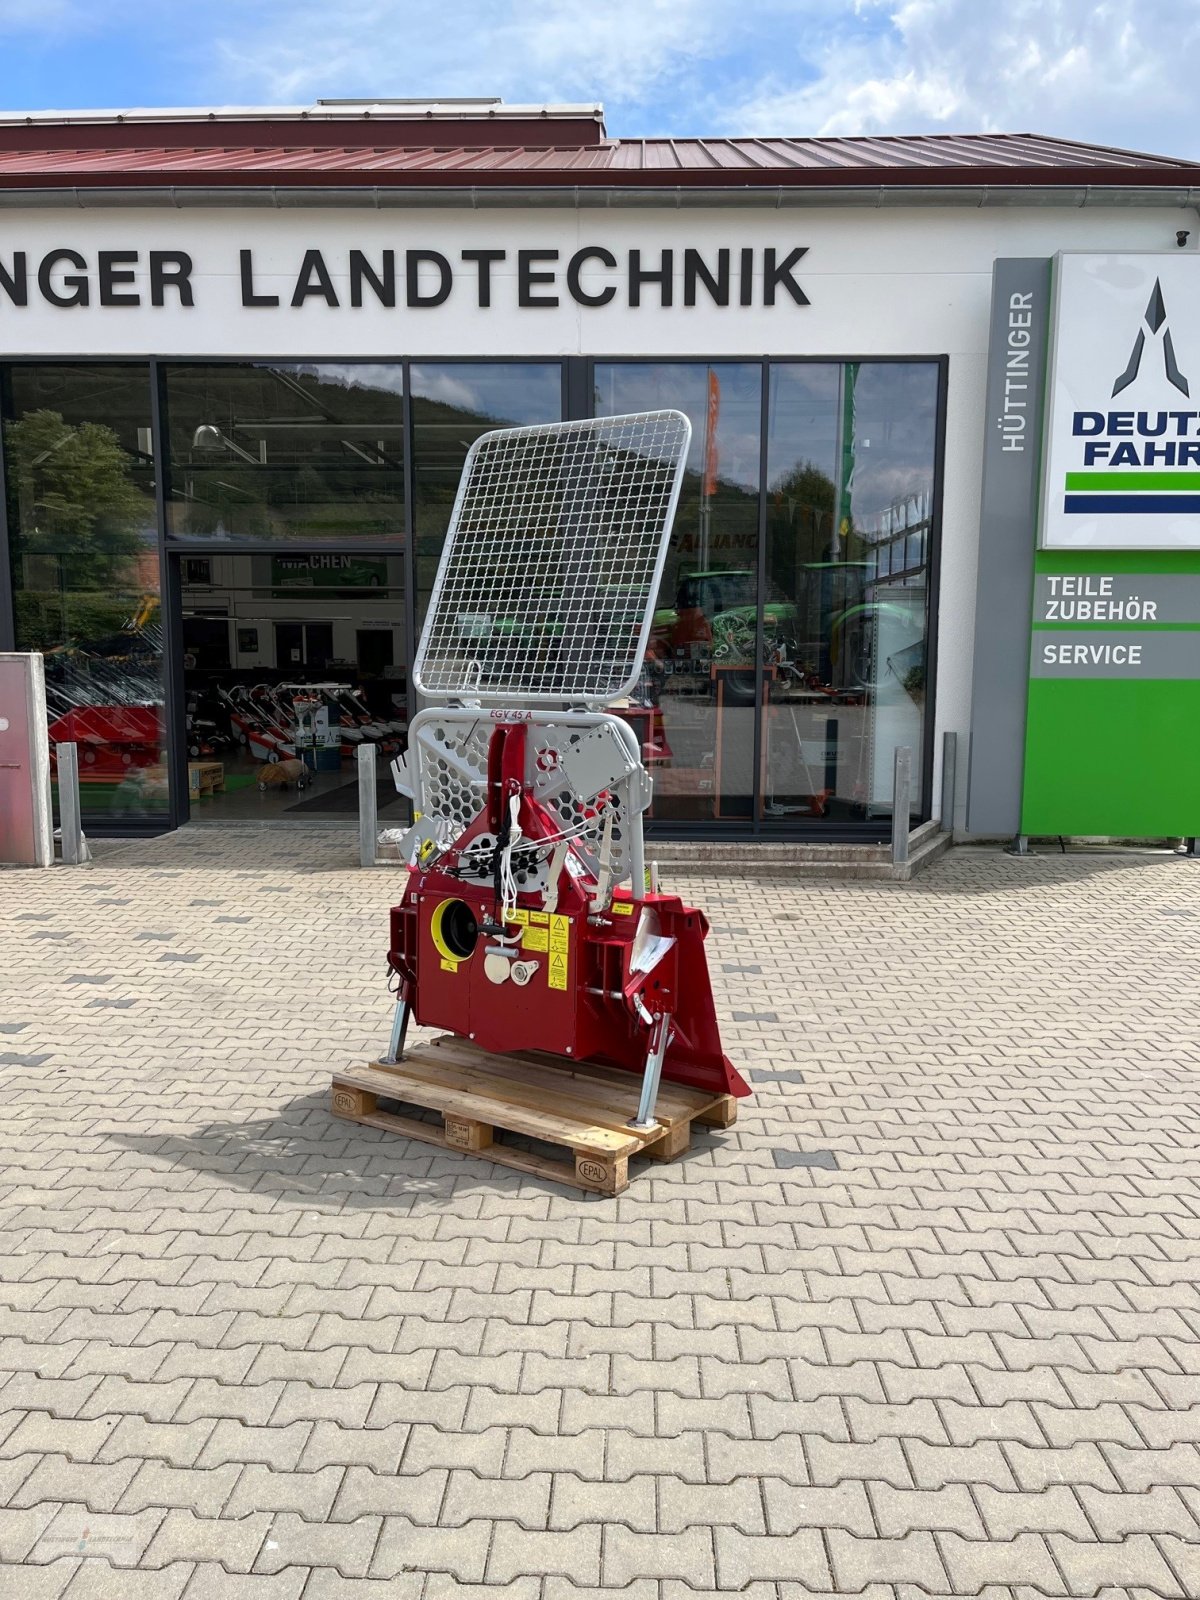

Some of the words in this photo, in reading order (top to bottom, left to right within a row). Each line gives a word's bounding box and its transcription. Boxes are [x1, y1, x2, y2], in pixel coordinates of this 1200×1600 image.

[239, 245, 812, 308] LANDTECHNIK
[997, 291, 1033, 452] HÜTTINGER
[1072, 411, 1200, 437] DEUT
[1083, 441, 1200, 466] FAHR
[1047, 576, 1114, 596] TEILE
[1045, 596, 1157, 620] ZUBEHÖR
[1043, 644, 1142, 665] SERVICE
[490, 709, 509, 718] EGV
[511, 710, 524, 719] 45
[525, 711, 532, 719] A
[338, 1095, 353, 1109] EPAL
[583, 1163, 603, 1180] EPAL
